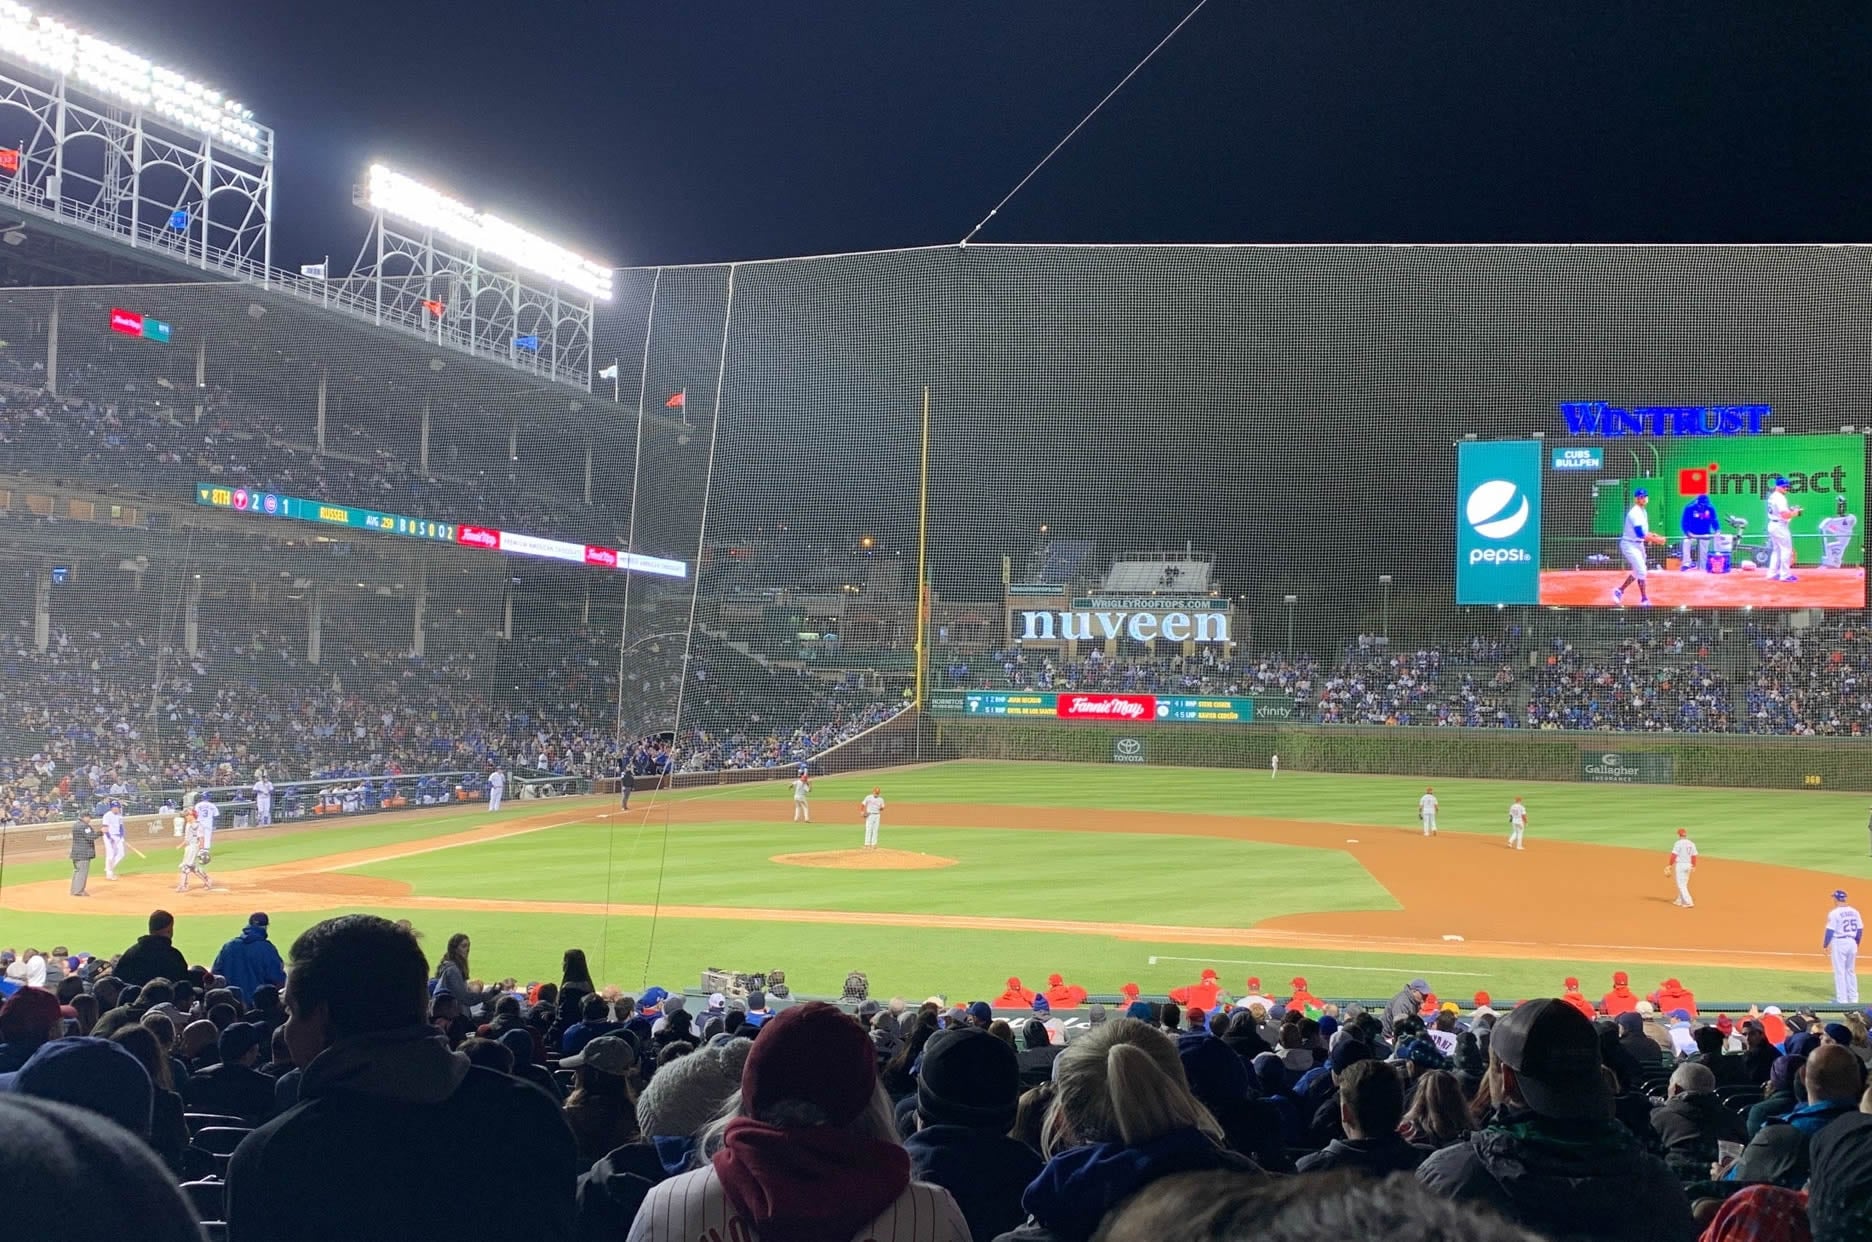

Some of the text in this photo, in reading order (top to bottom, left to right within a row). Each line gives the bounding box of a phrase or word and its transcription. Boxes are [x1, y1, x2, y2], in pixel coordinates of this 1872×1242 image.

[1560, 402, 1770, 437] WINTRUST
[1564, 450, 1590, 460] CUBS
[1555, 458, 1599, 468] BULLPEN
[1709, 463, 1847, 500] impact
[212, 489, 230, 505] 8TH
[252, 494, 259, 510] 2
[283, 499, 289, 515] 1
[320, 506, 348, 522] RUSSELL
[400, 518, 406, 532] B
[419, 521, 425, 535] S
[447, 526, 453, 540] 2
[1091, 599, 1211, 609] WRIGLEYROOFTOPS.COM
[1021, 611, 1230, 642] nuveen
[1069, 697, 1144, 718] Fannie May
[1256, 706, 1291, 717] xfinity
[1113, 754, 1144, 762] TOYOTA
[1585, 764, 1639, 777] Gallagher
[1843, 919, 1857, 932] 25
